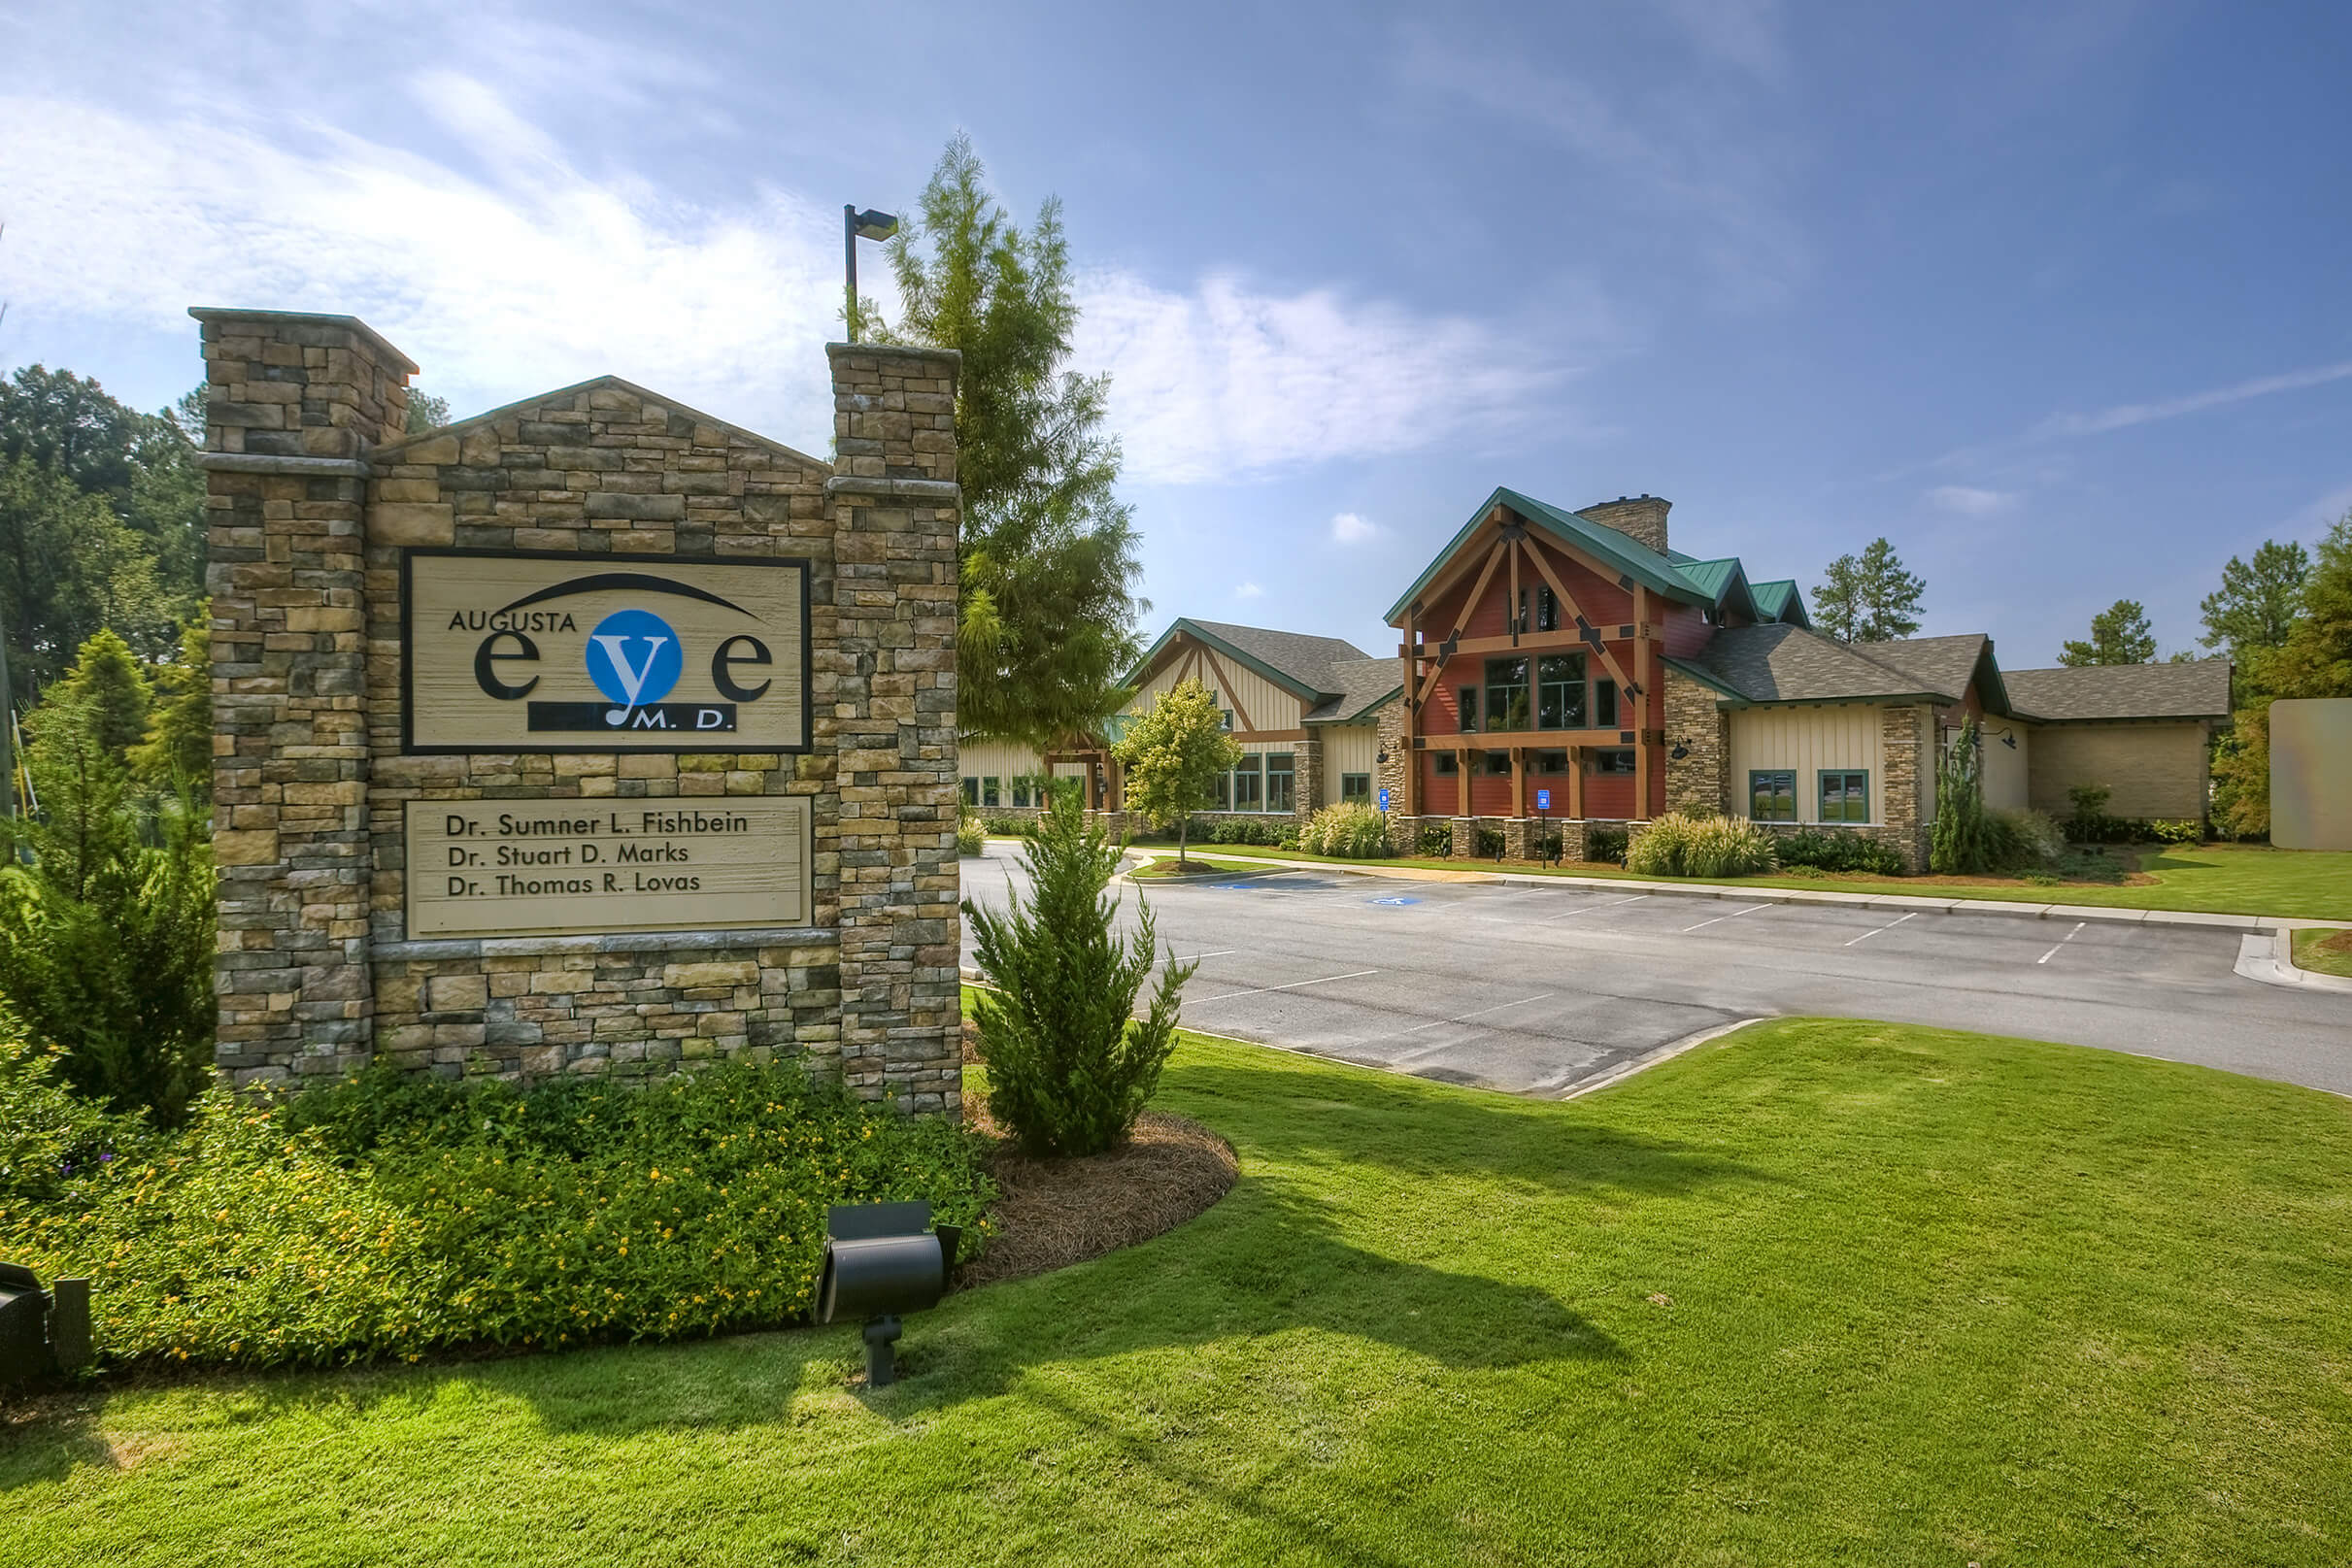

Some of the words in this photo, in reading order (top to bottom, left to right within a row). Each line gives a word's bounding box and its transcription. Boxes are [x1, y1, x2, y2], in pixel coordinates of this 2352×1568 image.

[449, 611, 577, 632] AUGUSTA
[474, 630, 773, 726] eye
[631, 709, 677, 729] M.
[696, 709, 734, 729] D.
[446, 815, 486, 836] Dr.
[498, 814, 600, 836] Sumner
[611, 813, 630, 834] L.
[643, 811, 748, 833] Fishbein
[449, 847, 486, 867] Dr.
[496, 846, 571, 866] Stuart
[582, 844, 607, 863] D.
[617, 841, 689, 863] Marks
[448, 876, 486, 896] Dr.
[495, 874, 593, 895] Thomas
[603, 873, 624, 892] R.
[635, 872, 700, 891] Lovas
